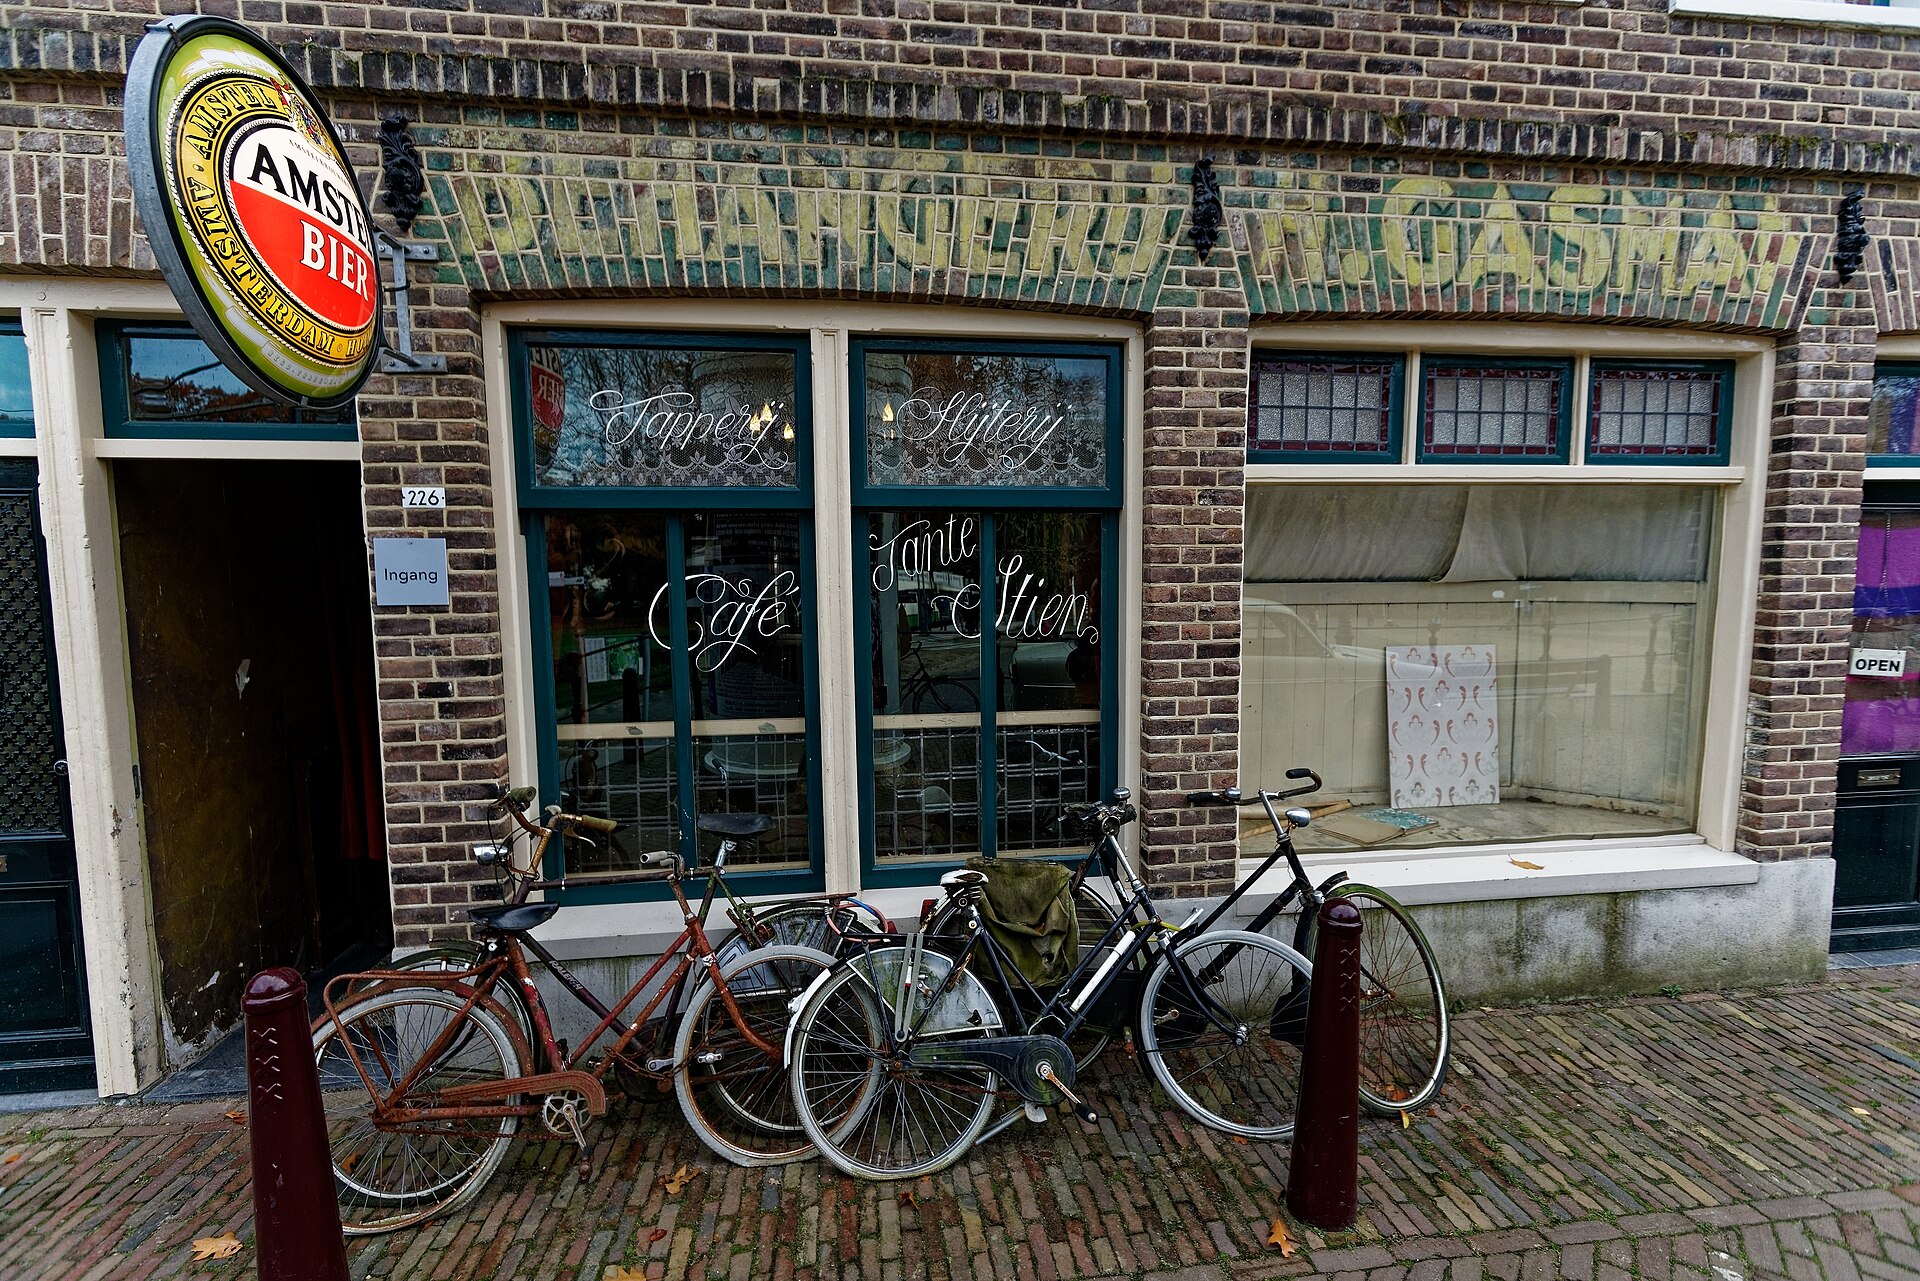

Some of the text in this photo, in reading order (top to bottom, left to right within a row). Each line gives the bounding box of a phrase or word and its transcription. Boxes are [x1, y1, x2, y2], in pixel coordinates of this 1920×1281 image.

[184, 83, 278, 161] AMSTEL
[187, 177, 335, 354] AMSTERDAM
[300, 218, 369, 302] BIER
[408, 490, 440, 506] 226
[384, 568, 439, 584] Ingang
[868, 514, 977, 592] Tante
[648, 571, 800, 673] Café
[931, 554, 1099, 645] Stien
[1855, 658, 1901, 672] OPEN
[548, 960, 584, 990] RALEIGH
